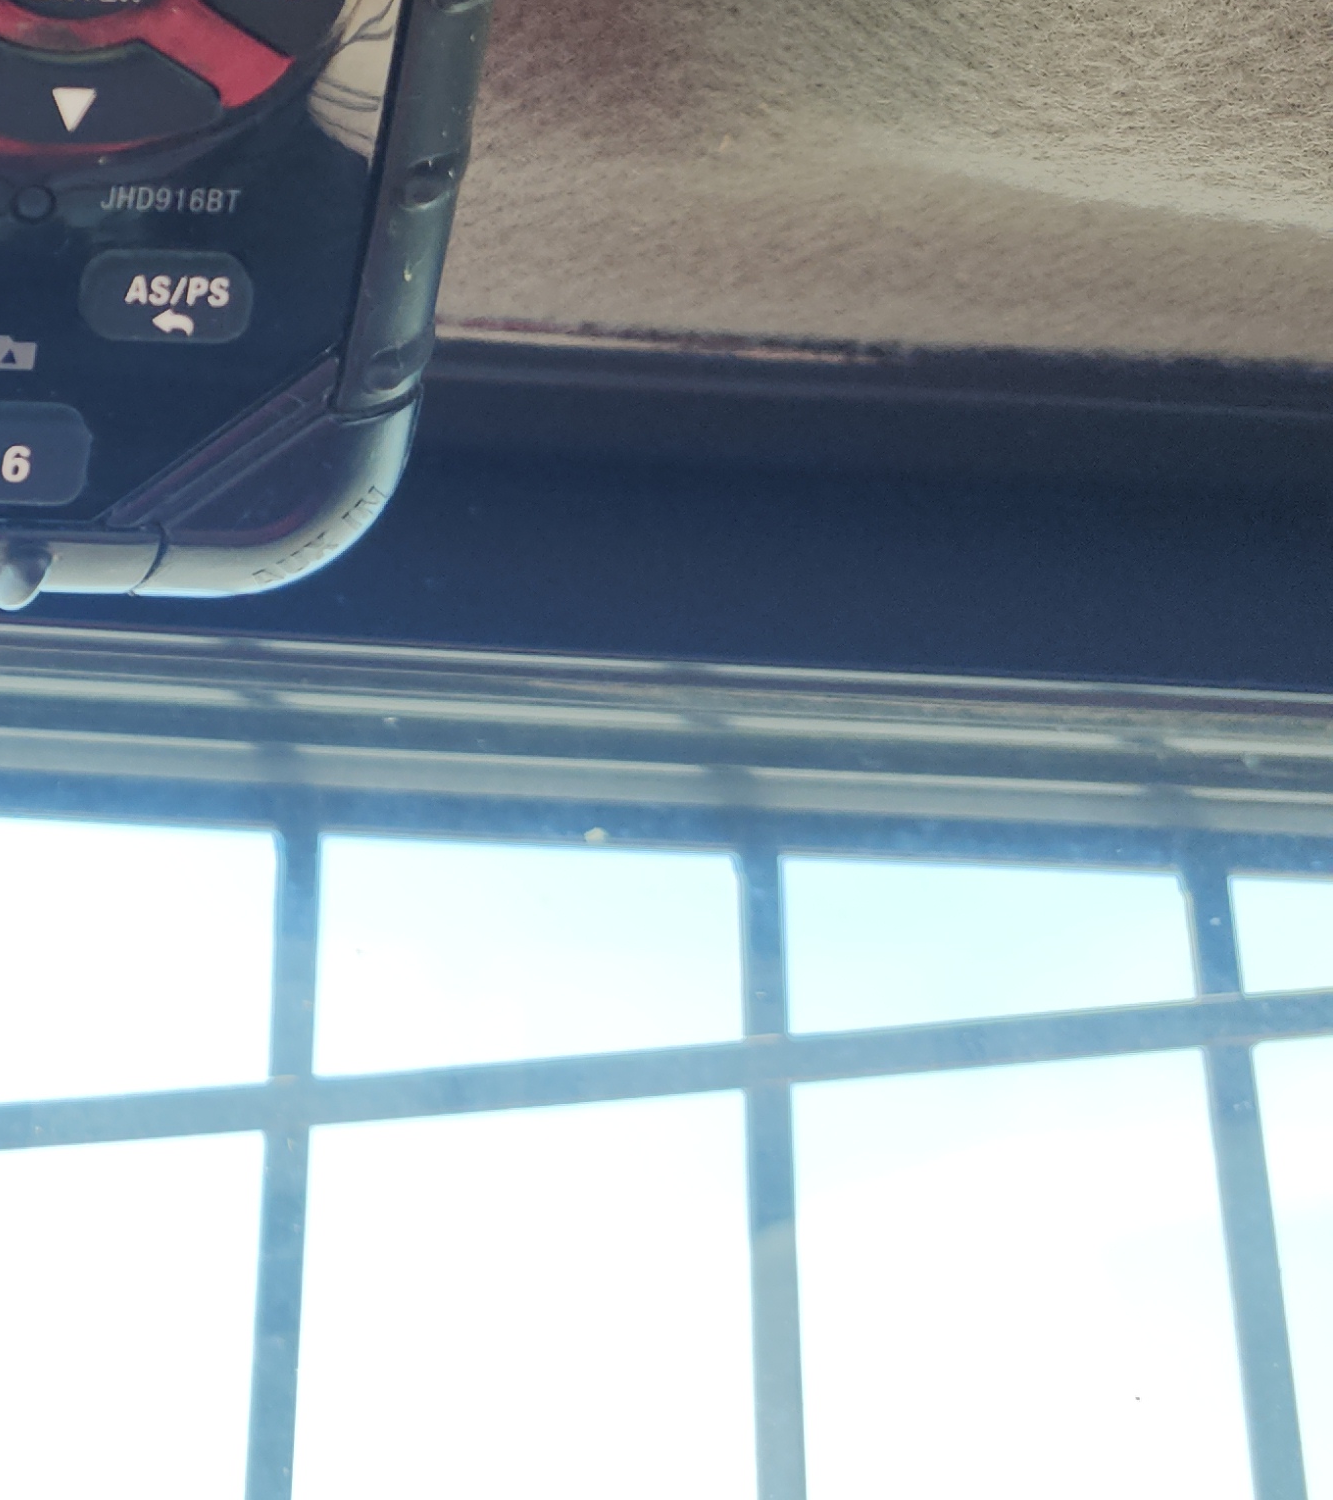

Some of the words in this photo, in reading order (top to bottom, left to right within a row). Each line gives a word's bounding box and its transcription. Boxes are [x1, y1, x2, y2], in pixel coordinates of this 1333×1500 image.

[100, 185, 241, 214] JHD916BT
[124, 274, 231, 308] AS/PS
[1, 444, 32, 483] 6
